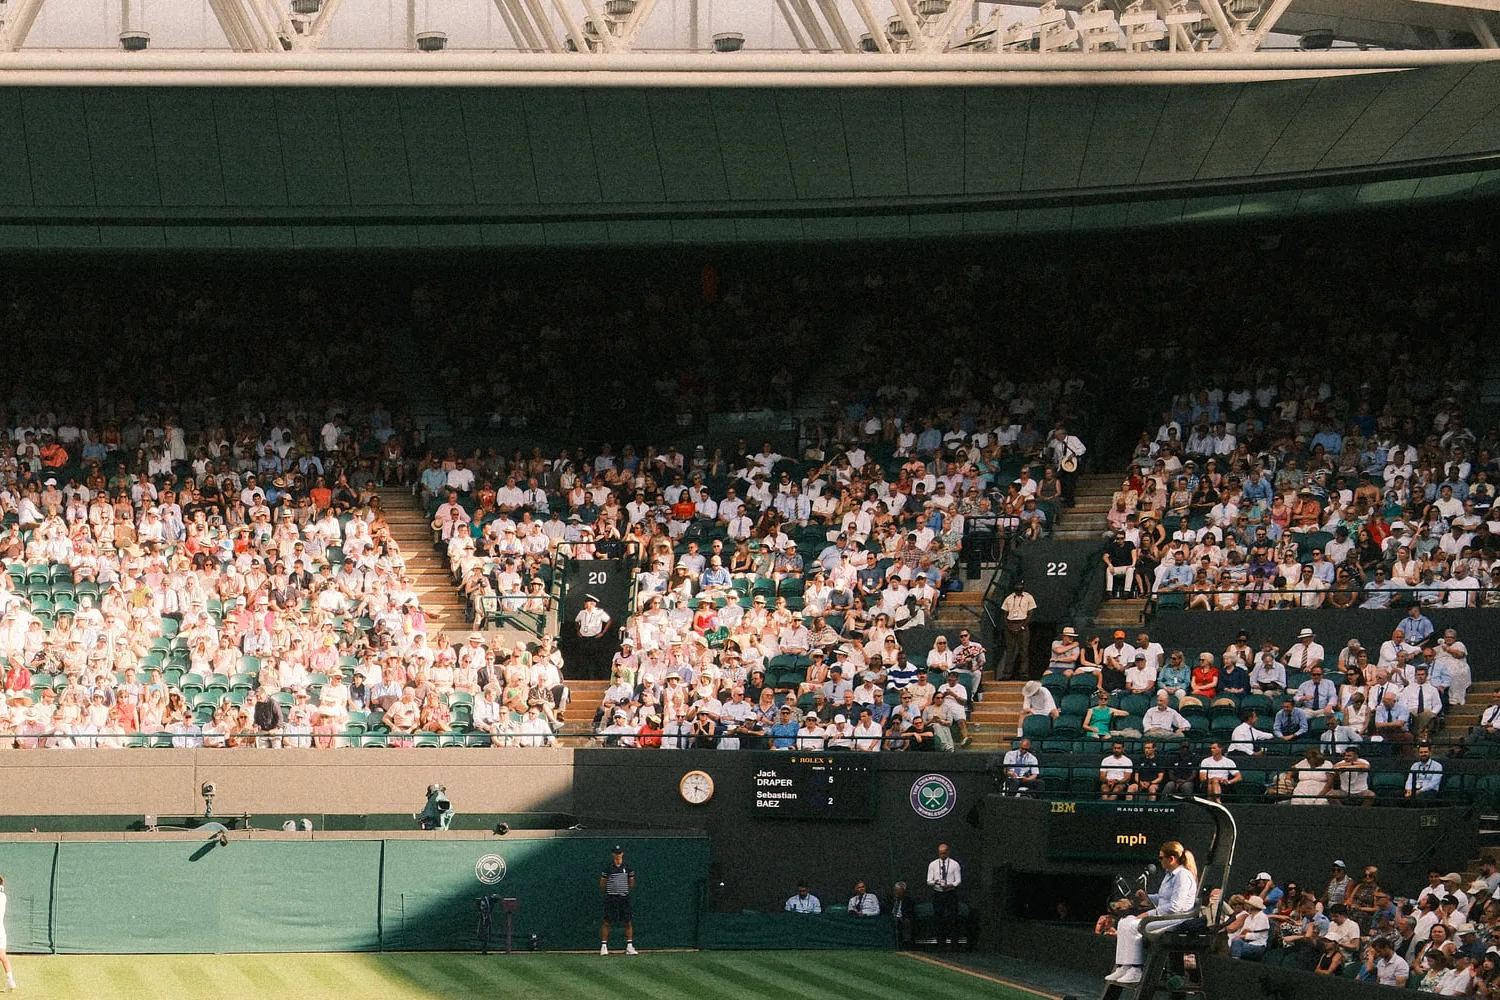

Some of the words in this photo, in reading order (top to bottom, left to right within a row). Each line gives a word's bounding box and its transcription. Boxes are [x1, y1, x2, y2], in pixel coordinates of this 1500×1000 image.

[1046, 562, 1067, 576] 22
[588, 571, 606, 585] 20
[756, 770, 777, 778] Jack
[756, 779, 793, 787] DRAPER
[828, 776, 834, 784] 5
[756, 791, 798, 799] Sebastian
[756, 800, 780, 808] BAEZ
[828, 797, 834, 805] 2
[1051, 801, 1076, 813] IBM
[1116, 833, 1147, 847] mph
